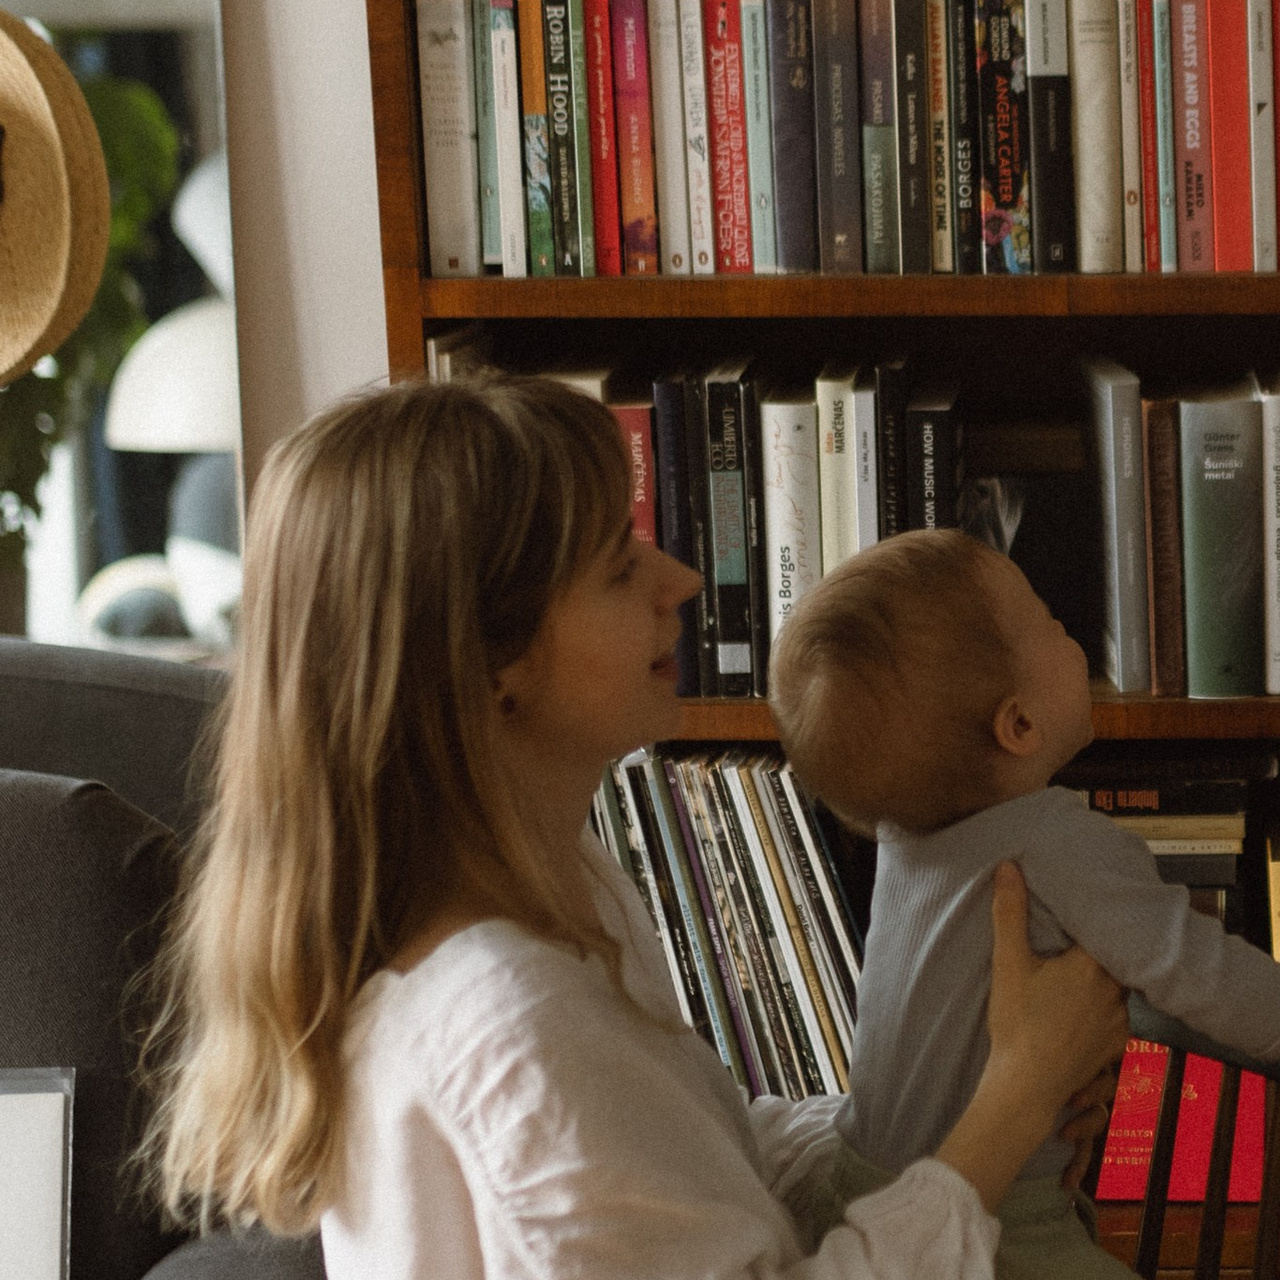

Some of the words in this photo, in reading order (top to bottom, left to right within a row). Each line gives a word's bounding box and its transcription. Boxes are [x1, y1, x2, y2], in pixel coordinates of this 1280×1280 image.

[546, 5, 566, 64] ROBIN
[623, 17, 637, 80] Milkman
[682, 11, 698, 76] LEONARD
[928, 2, 943, 54] JULIAN
[989, 15, 1000, 62] GORDON
[1000, 16, 1011, 62] EDMUND
[1181, 3, 1199, 68] BREASTS
[709, 44, 726, 124] JONATHAN
[725, 42, 740, 111] EXTREMELY
[905, 53, 916, 80] Kafka
[930, 57, 944, 113] BARNES
[1185, 71, 1200, 105] AND
[549, 73, 569, 136] HOOD
[933, 119, 944, 141] THE
[995, 75, 1011, 141] ANGELA
[1185, 108, 1201, 149] EGGS
[628, 113, 640, 152] ANNA
[729, 115, 744, 149] LOUD
[558, 148, 568, 175] DAVID
[631, 157, 643, 205] BURNS
[715, 125, 731, 192] SAFRAN
[934, 145, 945, 180] NOISE
[957, 139, 972, 209] BORGES
[998, 145, 1013, 203] CARTER
[733, 164, 746, 227] INCREDIBLY
[871, 153, 884, 244] PASAKOJIMAI
[935, 183, 946, 200] OF
[936, 202, 947, 231] TIME
[1184, 160, 1195, 221] KAWAKAMI
[1195, 173, 1205, 208] MIEKO
[718, 194, 733, 251] FOER
[734, 227, 750, 266] CLOSE
[722, 407, 737, 469] UMBERTO
[833, 400, 846, 454] MARČĖNAS
[922, 423, 934, 455] HOW
[1122, 417, 1134, 478] HEROINES
[630, 432, 646, 502] MARČĖNAS
[711, 442, 724, 470] ECO
[923, 458, 935, 497] MUSIC
[924, 501, 936, 532] WOR
[777, 546, 793, 599] Borges
[707, 917, 718, 936] FRANK
[712, 936, 723, 954] ZAPPA
